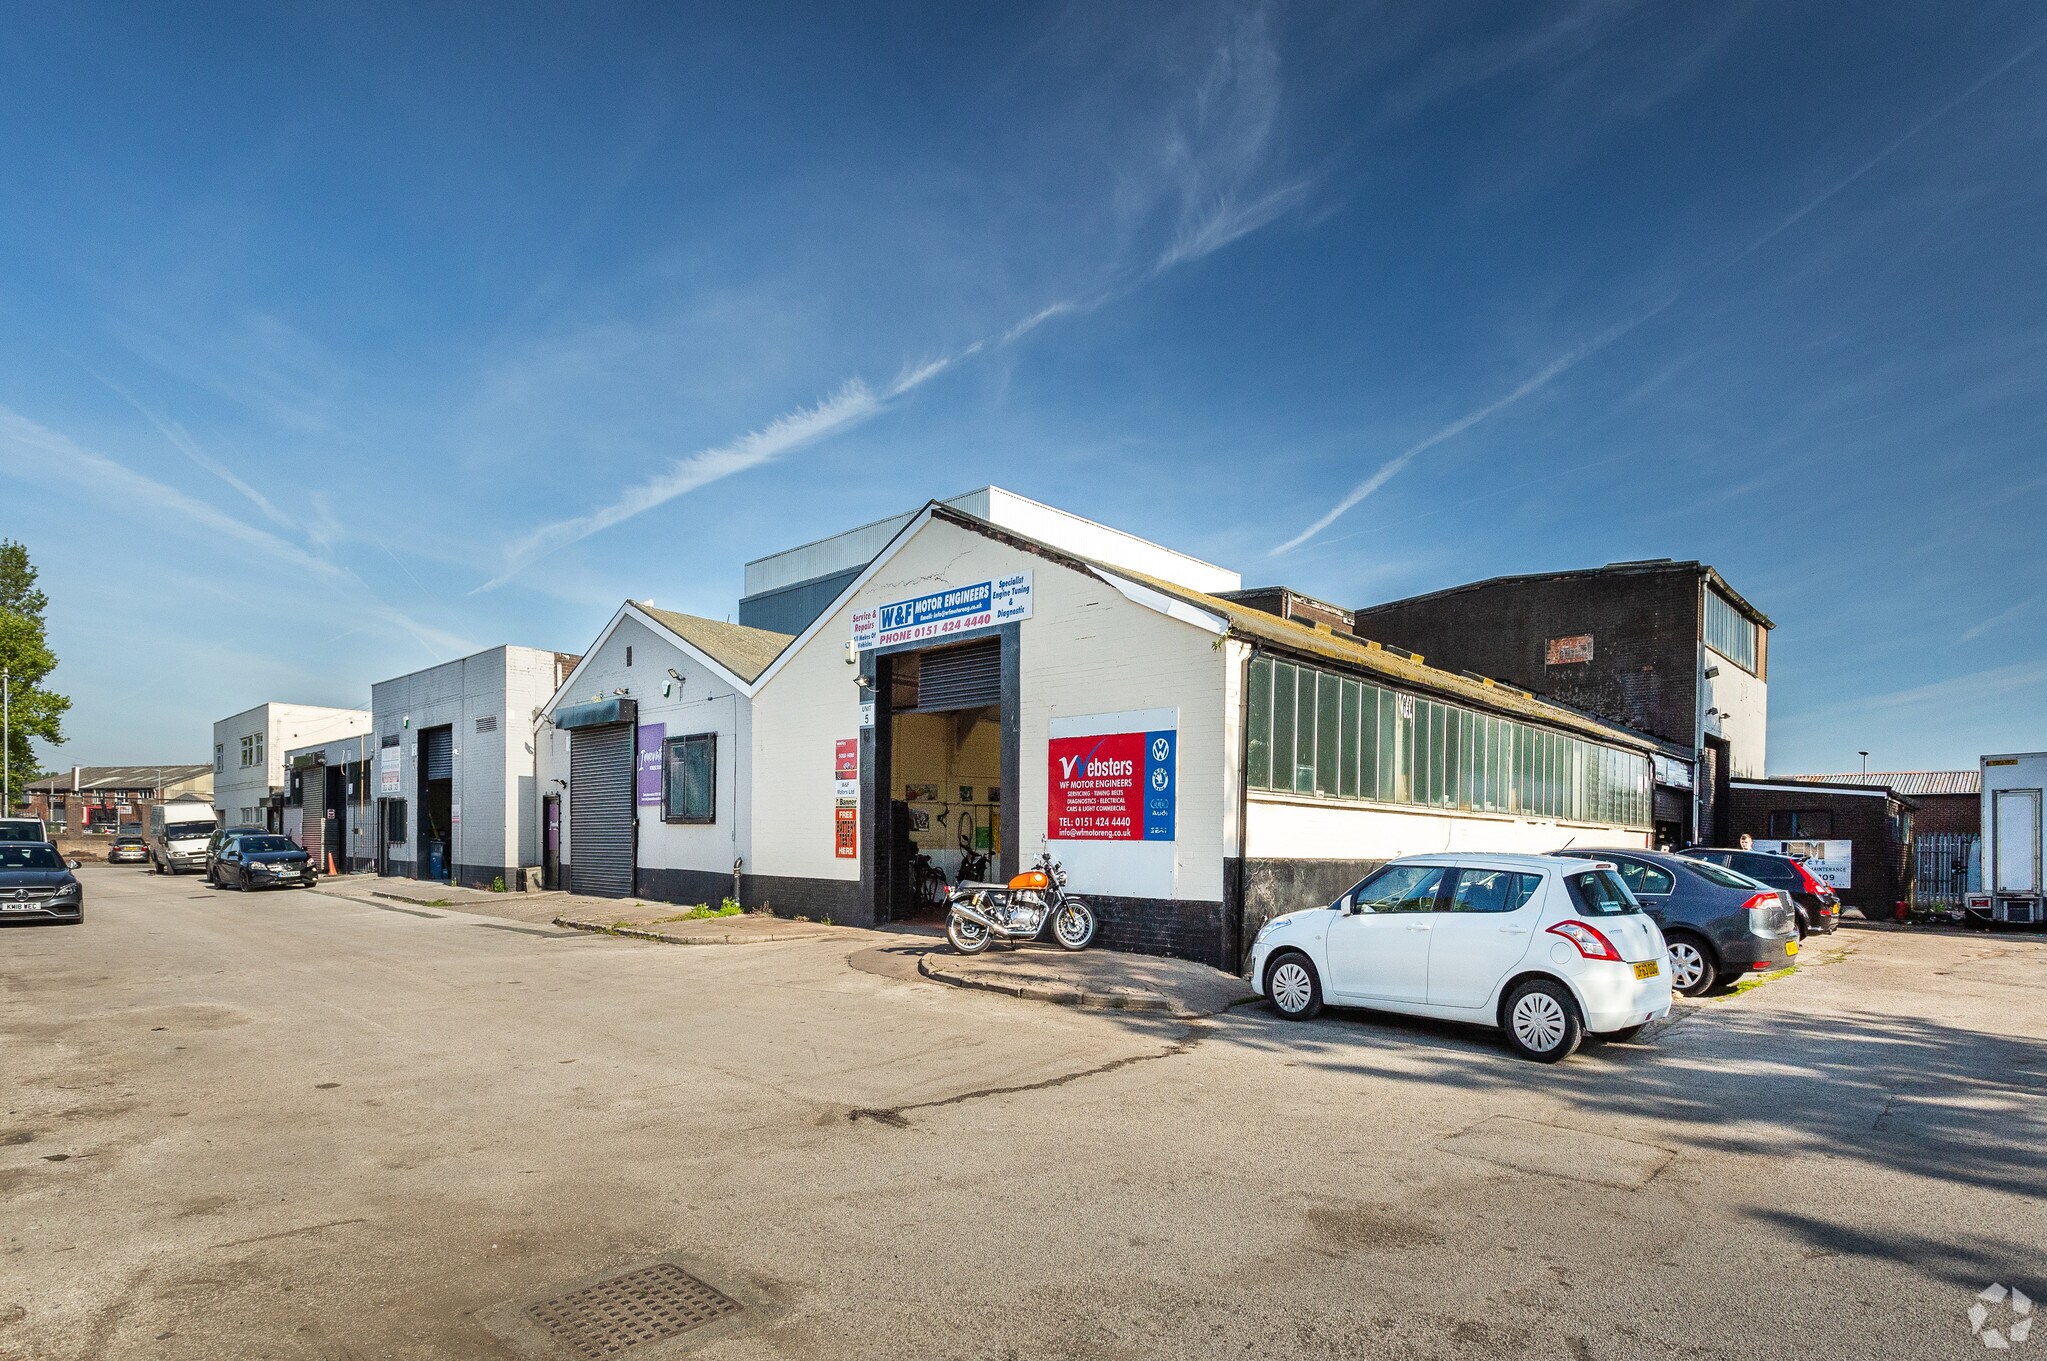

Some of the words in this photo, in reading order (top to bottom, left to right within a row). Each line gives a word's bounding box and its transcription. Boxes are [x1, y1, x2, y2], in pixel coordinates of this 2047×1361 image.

[998, 576, 1024, 589] Specialist
[993, 590, 1010, 600] Engine
[1012, 585, 1029, 594] Tuning
[915, 596, 942, 614] MOTOR
[944, 584, 990, 608] ENGINEERS
[1008, 598, 1013, 606] &
[852, 612, 871, 622] Service
[872, 610, 876, 618] &
[882, 602, 913, 628] W&F
[854, 620, 874, 633] Repairs
[880, 629, 912, 644] PHONE
[914, 624, 938, 638] 0151
[942, 620, 961, 632] 424
[964, 614, 990, 628] 4440
[864, 714, 868, 724] 5
[1070, 780, 1094, 788] MOTOR
[1096, 778, 1132, 788] ENGINEERS
[1058, 818, 1074, 826] TEL:
[1075, 818, 1092, 826] 0151
[1096, 817, 1109, 826] 424
[1112, 817, 1130, 826] 4440
[1058, 828, 1131, 838] info@wfmotoreng.co.uk
